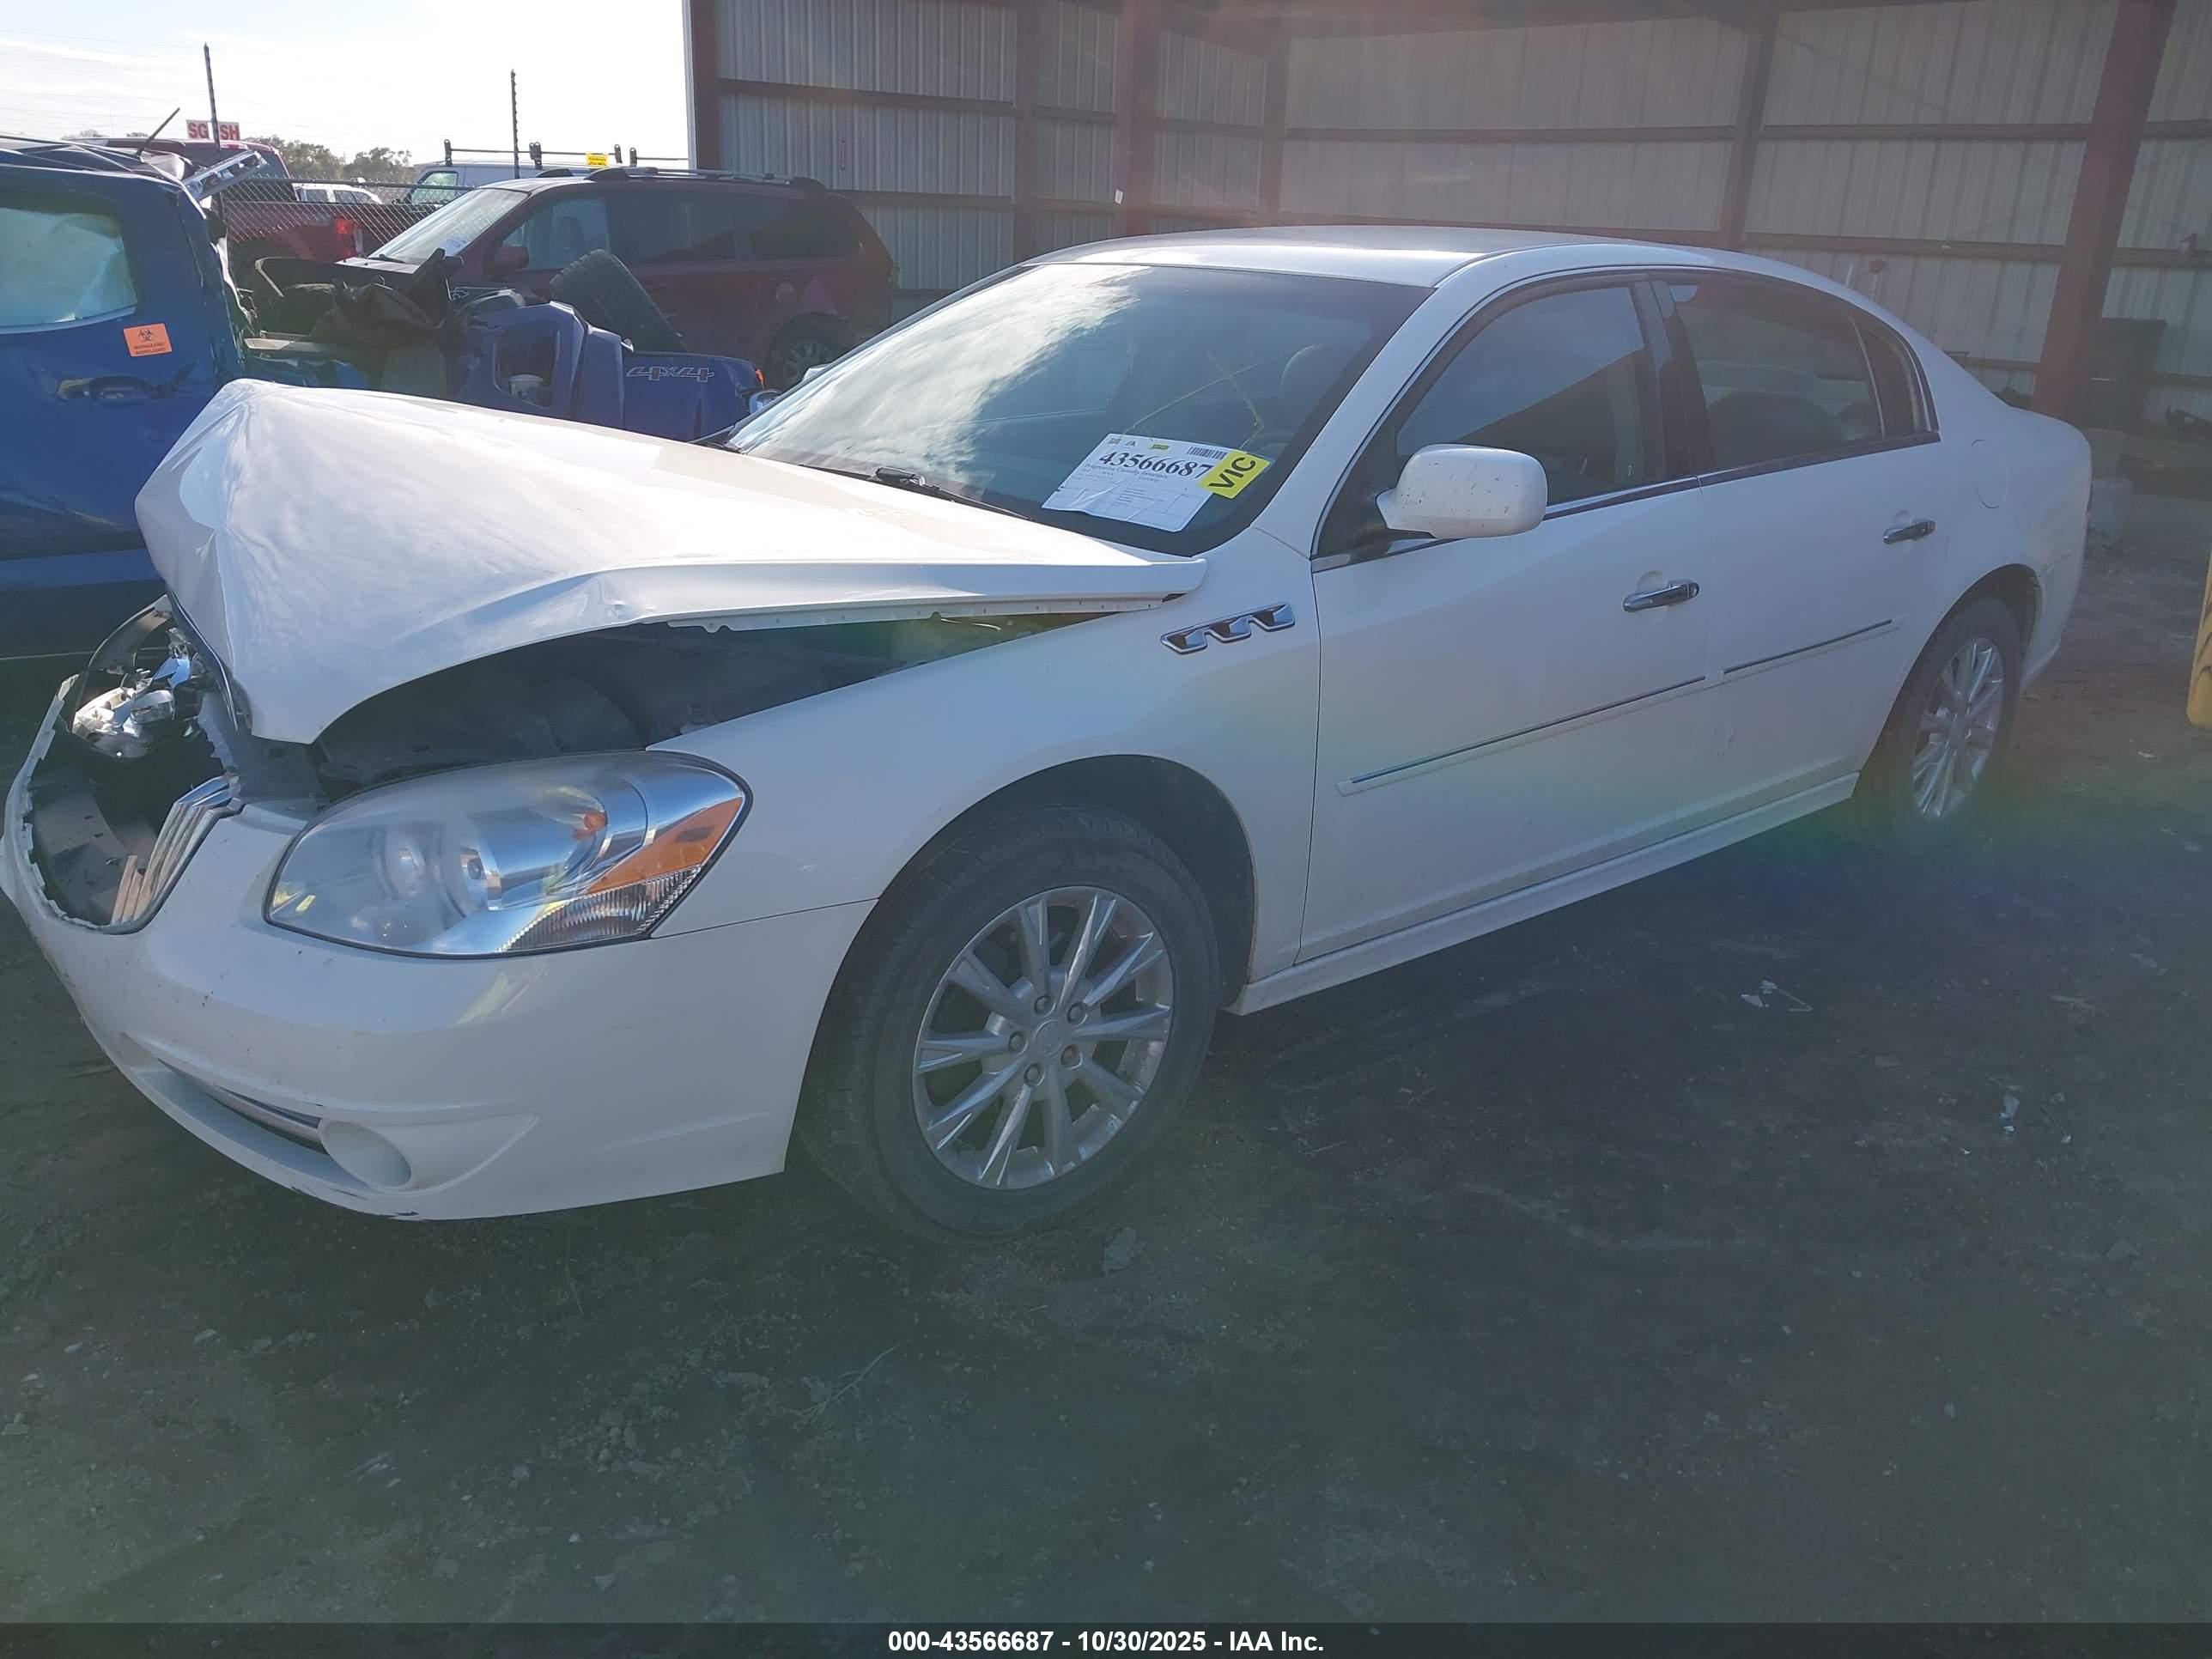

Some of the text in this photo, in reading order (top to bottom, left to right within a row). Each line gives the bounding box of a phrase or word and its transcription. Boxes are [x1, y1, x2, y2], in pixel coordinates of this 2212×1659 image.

[219, 125, 240, 140] SH
[1099, 451, 1215, 479] 43566687
[1207, 457, 1256, 488] VIC
